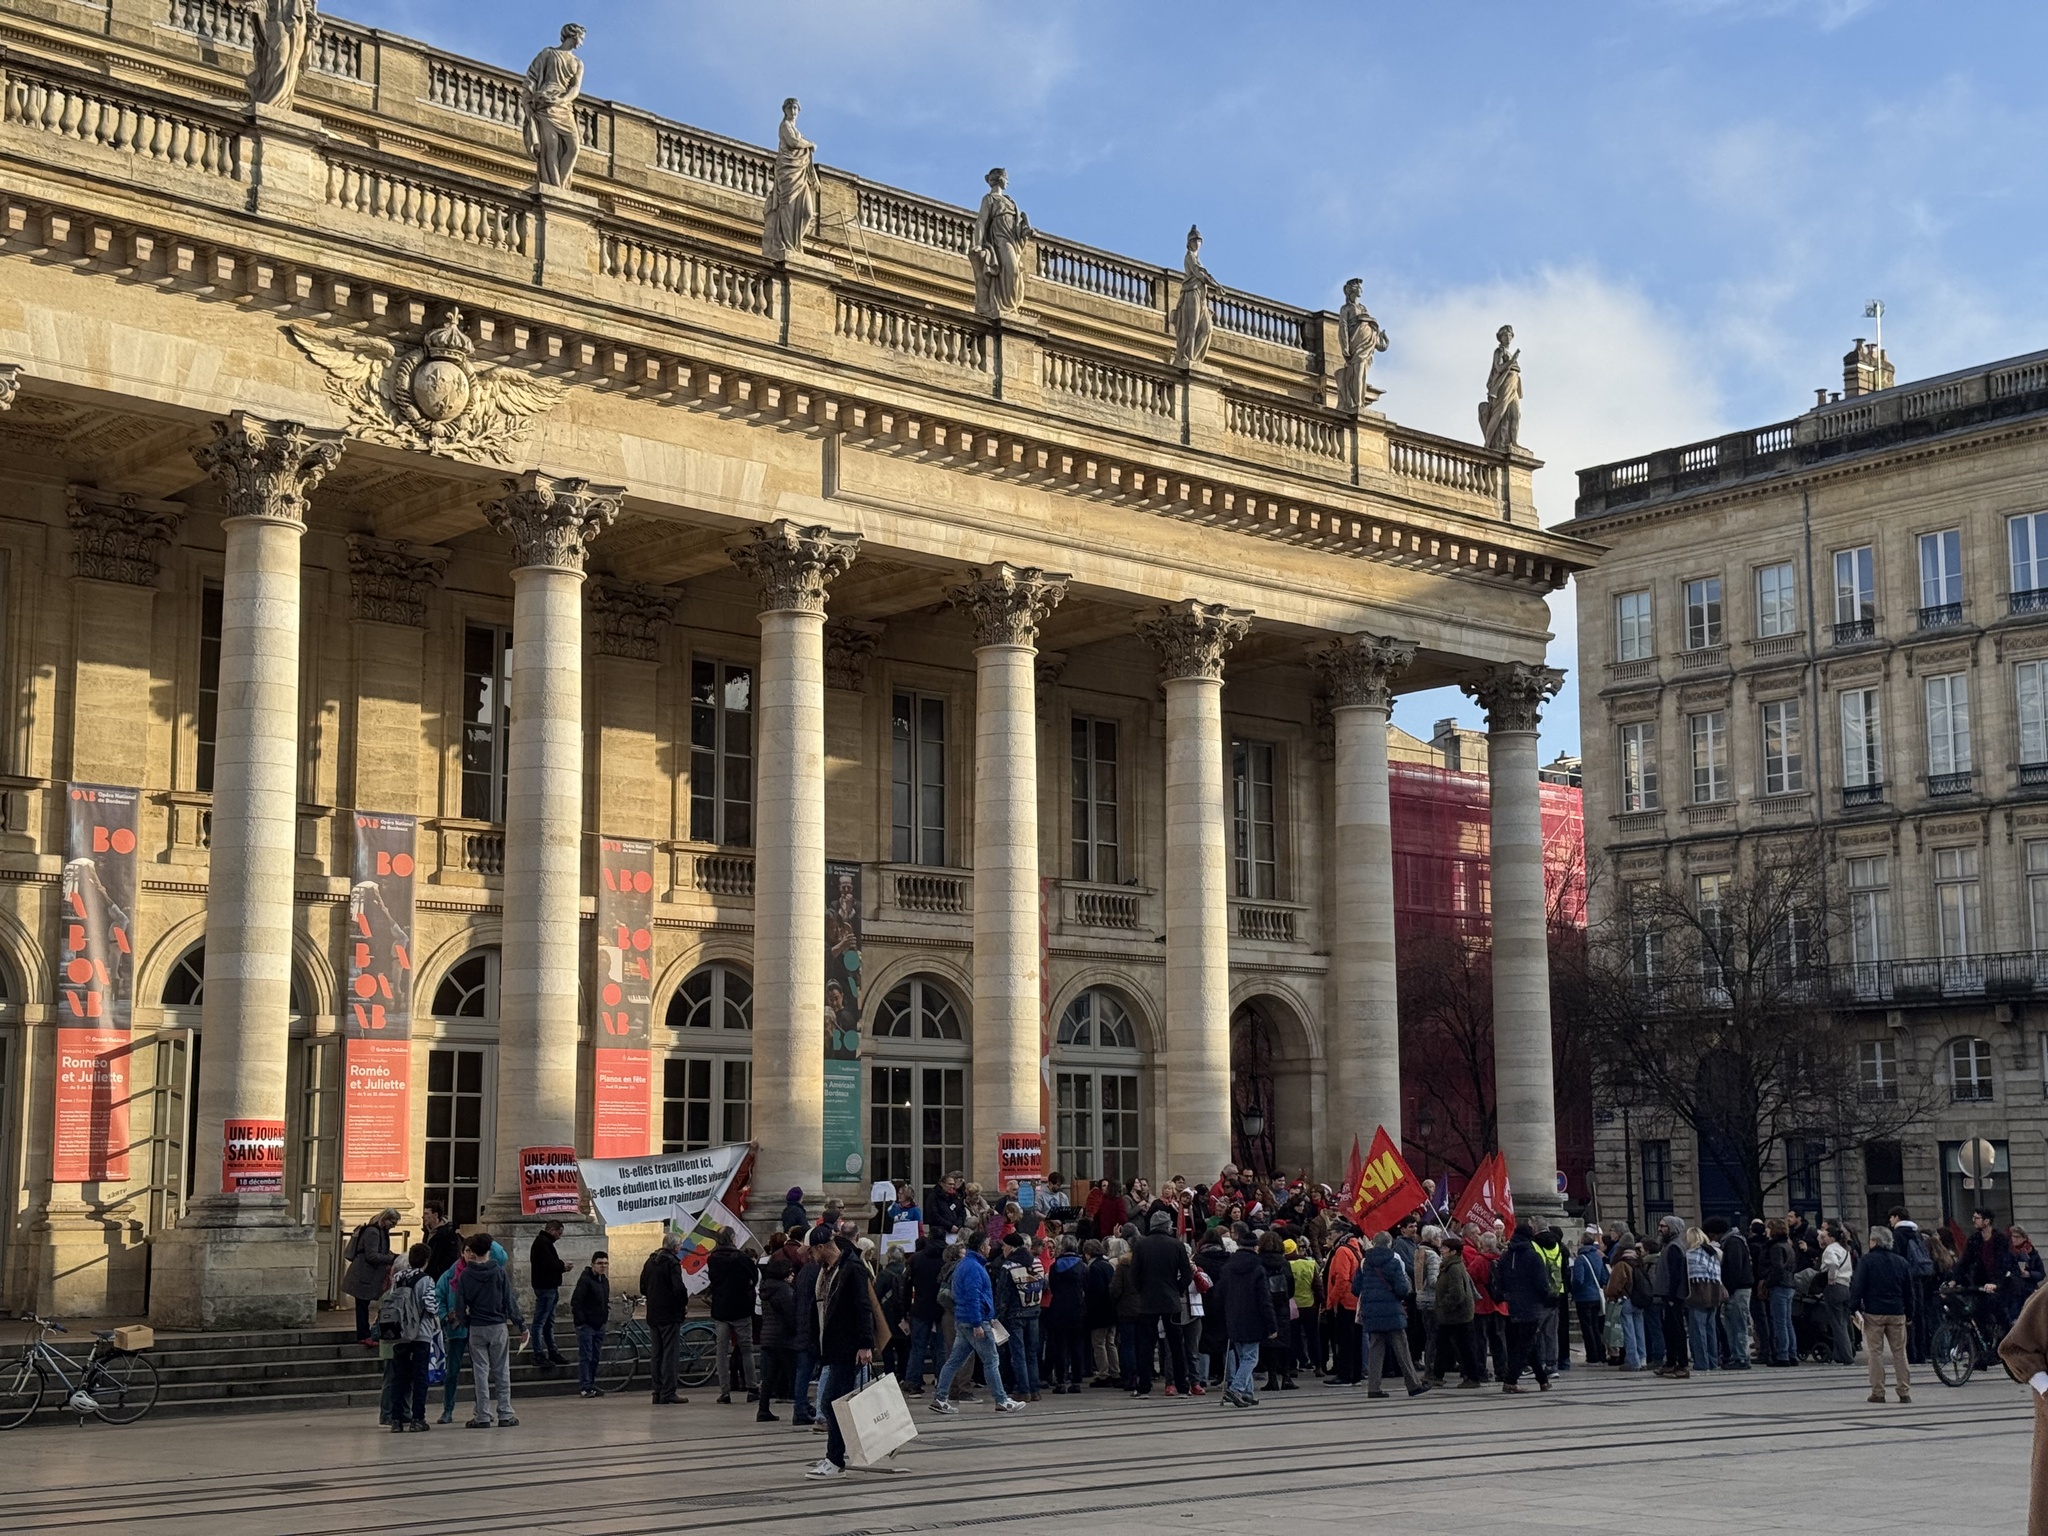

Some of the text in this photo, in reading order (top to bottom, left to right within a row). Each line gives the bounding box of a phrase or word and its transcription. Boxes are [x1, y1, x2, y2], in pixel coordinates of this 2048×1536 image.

[61, 1070, 124, 1083] et Juliette
[350, 1065, 391, 1076] Roméo
[350, 1078, 406, 1090] et Juliette
[599, 1074, 622, 1083] Pianos
[632, 1075, 647, 1084] fête
[824, 1089, 849, 1097] Bordeaux
[229, 1126, 254, 1140] UNE
[1002, 1138, 1021, 1150] UNE
[228, 1143, 265, 1161] SANS
[524, 1152, 545, 1167] UNE
[1002, 1153, 1029, 1167] SANS
[618, 1156, 714, 1179] Ils-elles travaillent ici,
[525, 1169, 555, 1185] SANS
[622, 1179, 659, 1194] étudient
[659, 1176, 673, 1190] ici,
[673, 1173, 708, 1188] ils-elles
[617, 1195, 667, 1212] Régularisez
[668, 1188, 712, 1204] maintenant
